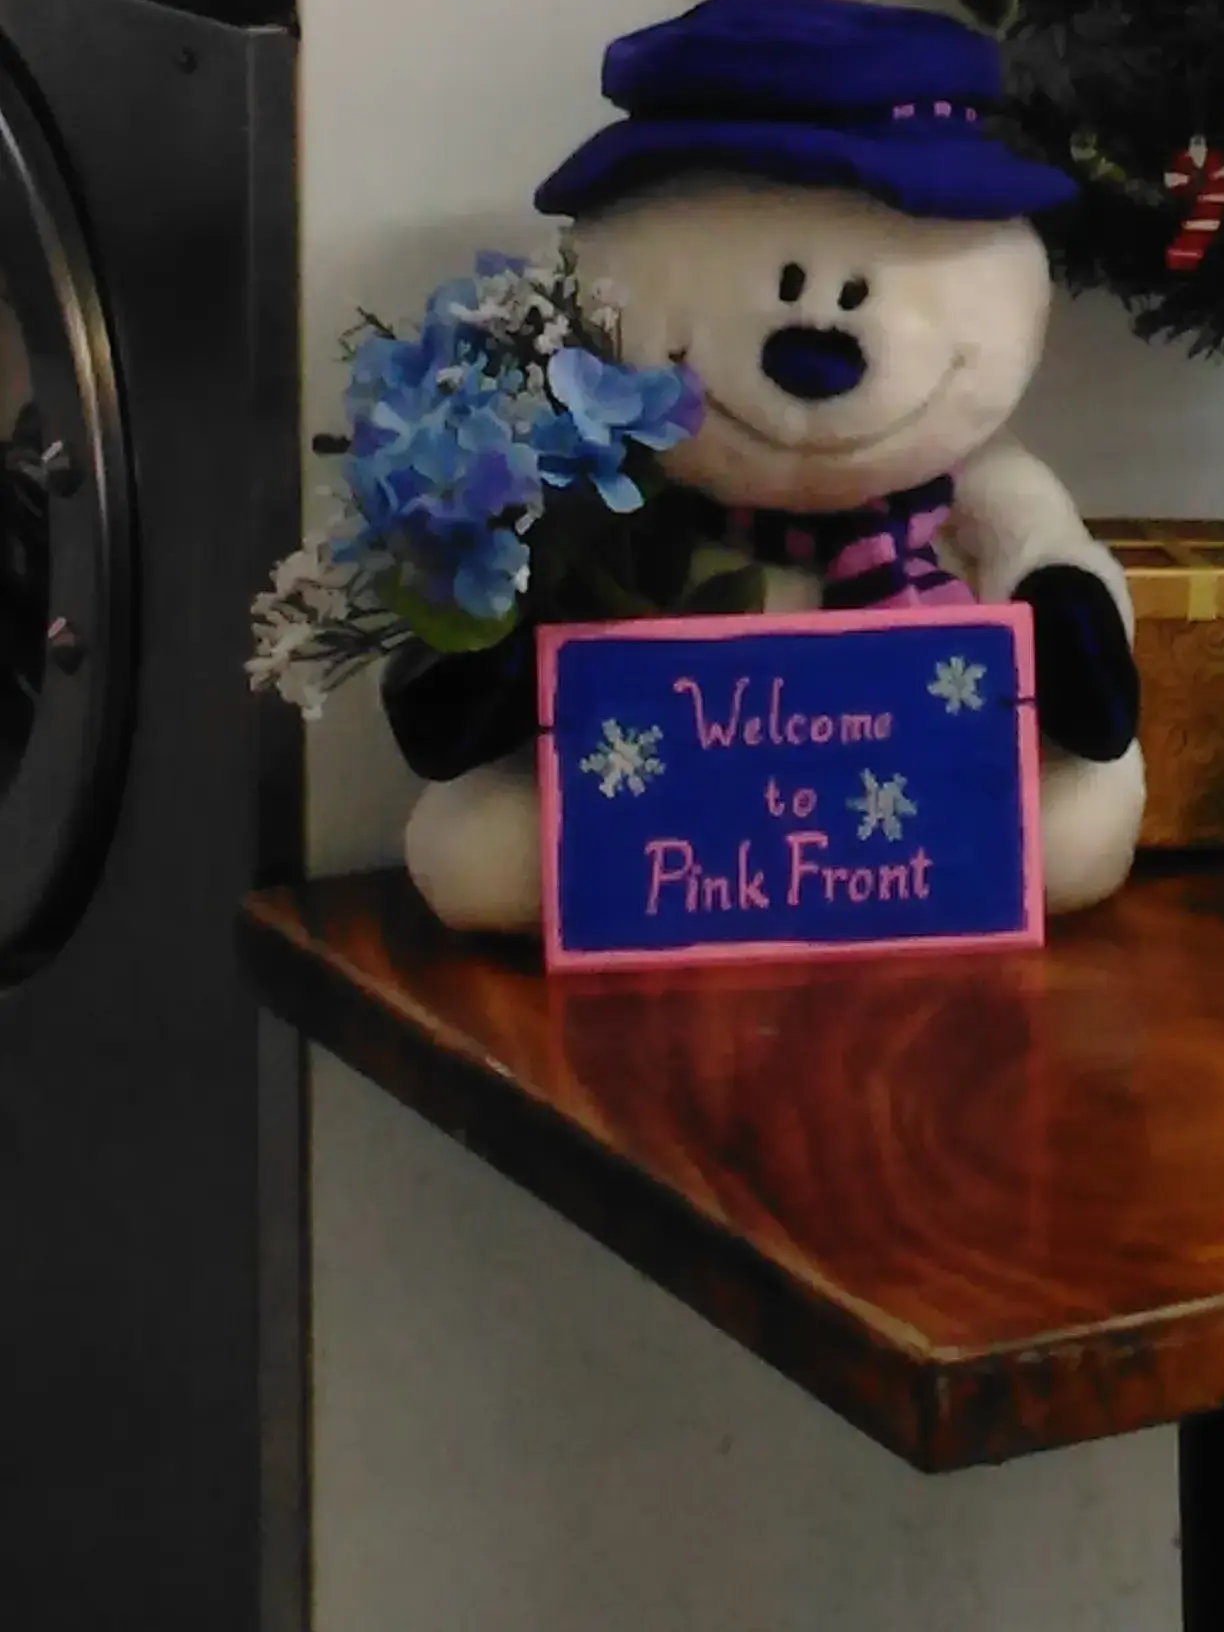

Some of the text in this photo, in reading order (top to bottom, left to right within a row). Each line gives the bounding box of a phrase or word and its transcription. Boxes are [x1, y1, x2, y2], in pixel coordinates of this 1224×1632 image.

[672, 676, 894, 749] Welcome
[764, 776, 819, 818] to
[644, 830, 935, 916] Pink Front
